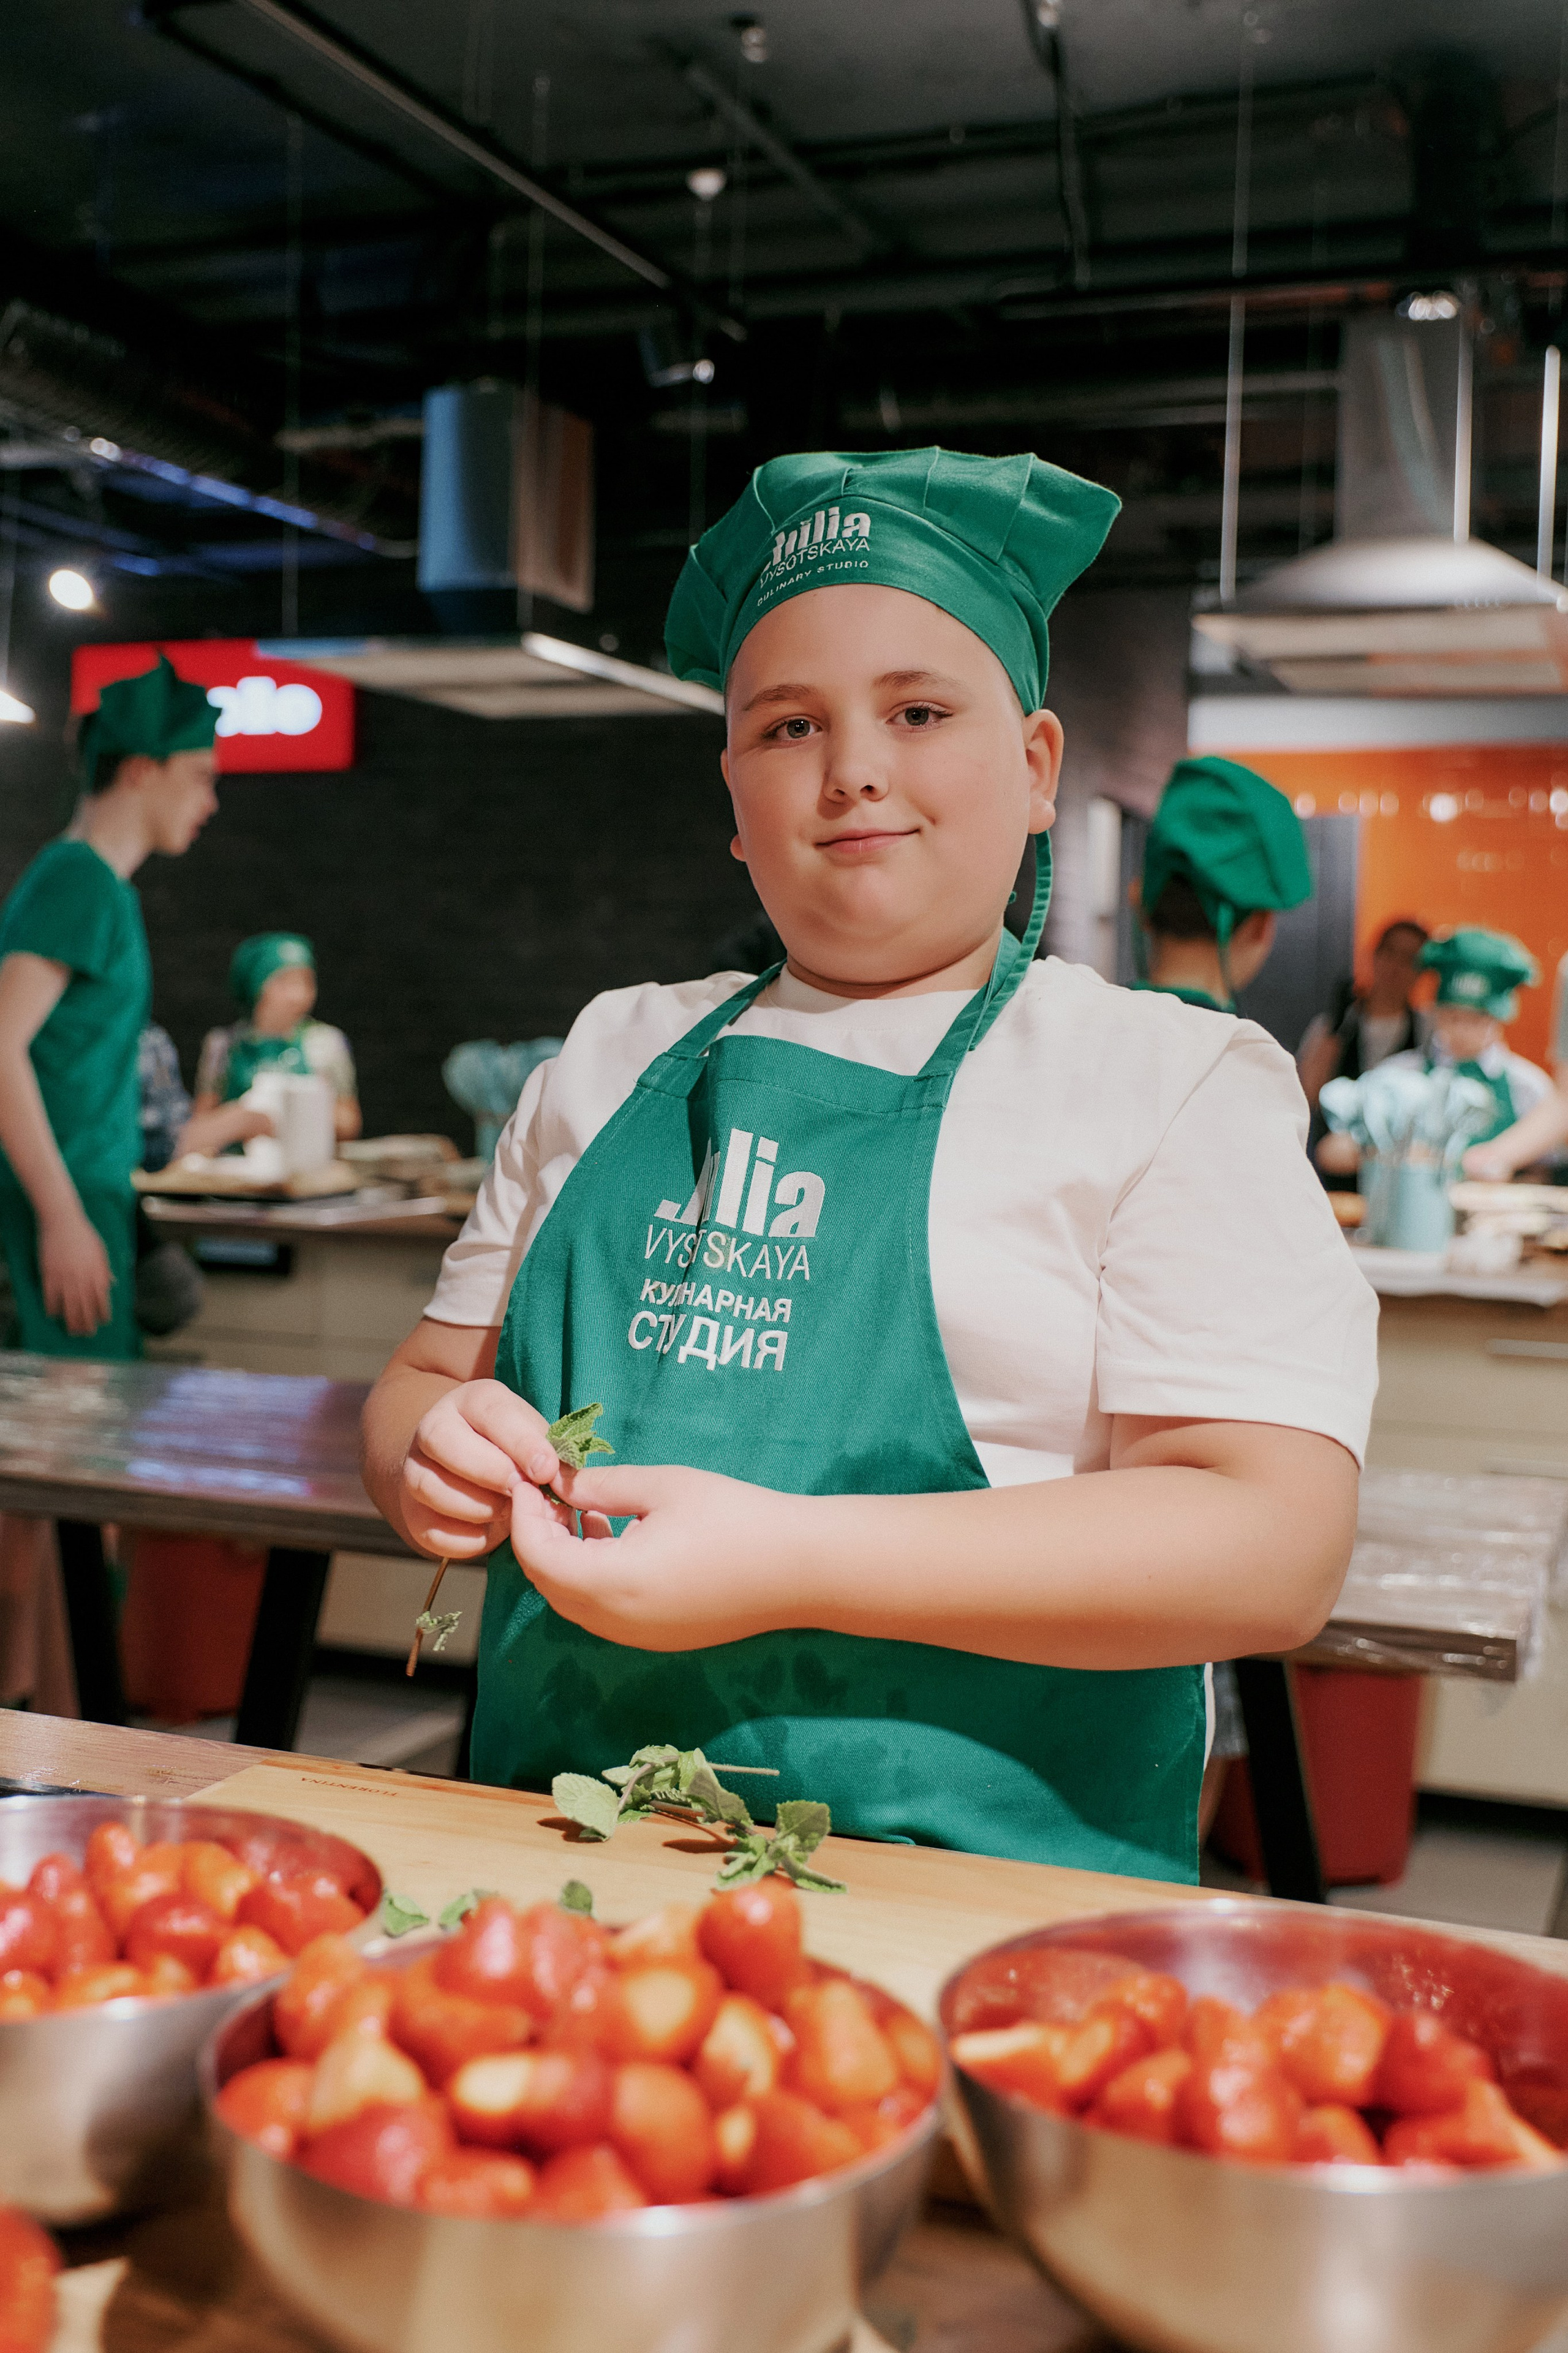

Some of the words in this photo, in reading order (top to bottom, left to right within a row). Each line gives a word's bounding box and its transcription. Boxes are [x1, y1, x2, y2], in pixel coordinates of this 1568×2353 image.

[757, 570, 812, 606] CULINARY
[817, 560, 869, 573] STUDIO
[654, 1128, 826, 1238] Jlia
[644, 1224, 810, 1280] VYSTSKAYA
[628, 1310, 788, 1372] СТУДИЯ
[301, 1777, 398, 1796] FLORENTINA
